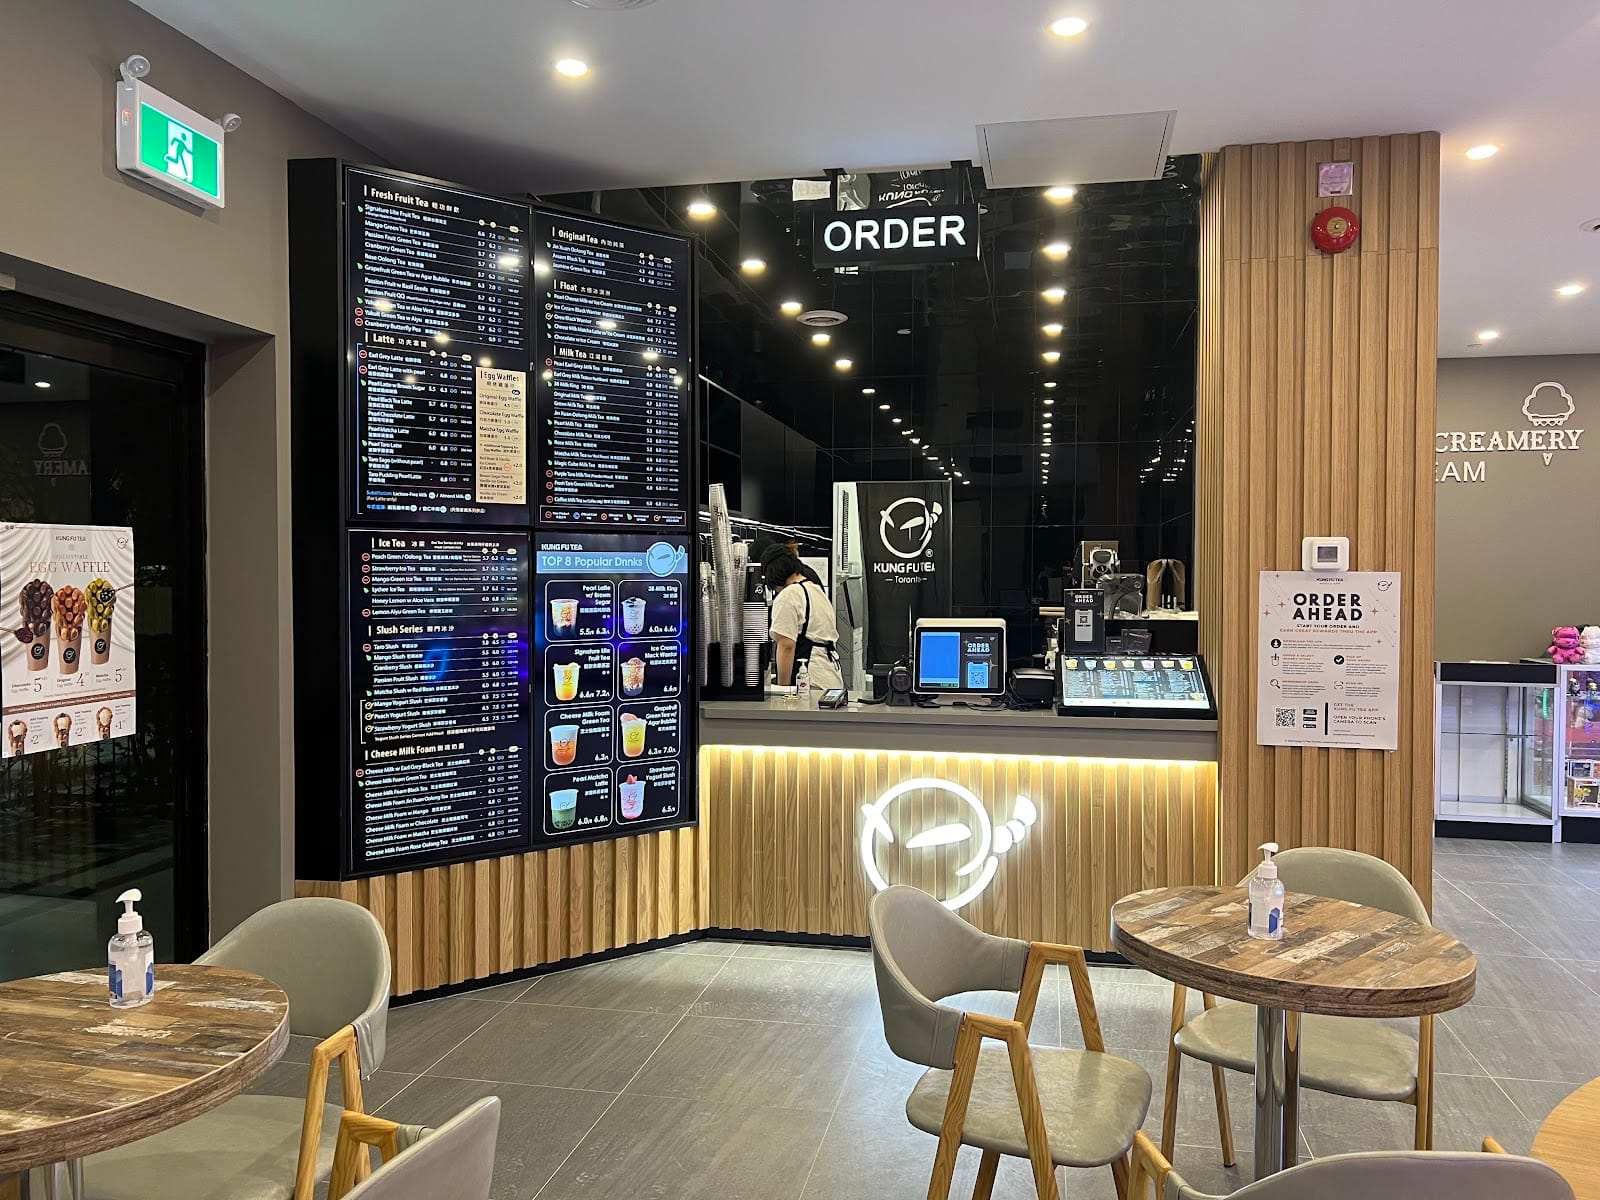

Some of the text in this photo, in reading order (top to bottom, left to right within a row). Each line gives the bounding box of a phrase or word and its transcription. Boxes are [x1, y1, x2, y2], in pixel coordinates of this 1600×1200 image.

[371, 188, 393, 200] Fresh
[394, 193, 414, 205] Fruit
[415, 197, 429, 207] Tea
[365, 220, 383, 229] Mango
[365, 231, 384, 239] Passion
[559, 230, 585, 241] Original
[586, 235, 598, 244] Tea
[824, 215, 966, 251] ORDER
[365, 242, 390, 251] Cranberry
[378, 256, 396, 265] Oolong
[560, 281, 577, 292] Float
[373, 333, 395, 344] Latte
[559, 348, 574, 357] Milk
[575, 350, 586, 358] Tea
[484, 372, 495, 381] Egg
[1435, 430, 1584, 453] CREAMERY
[1435, 461, 1486, 482] AM
[392, 539, 406, 547] Tea
[30, 562, 110, 572] EGG WAFFLE
[542, 556, 642, 568] TOP 8 Popular Drinks
[874, 563, 905, 572] KUNG
[907, 563, 919, 572] FU
[1293, 593, 1362, 606] ORDER
[1293, 608, 1362, 620] AHEAD
[376, 625, 423, 634] Slush Series
[371, 746, 436, 758] Cheese Milk Foam
